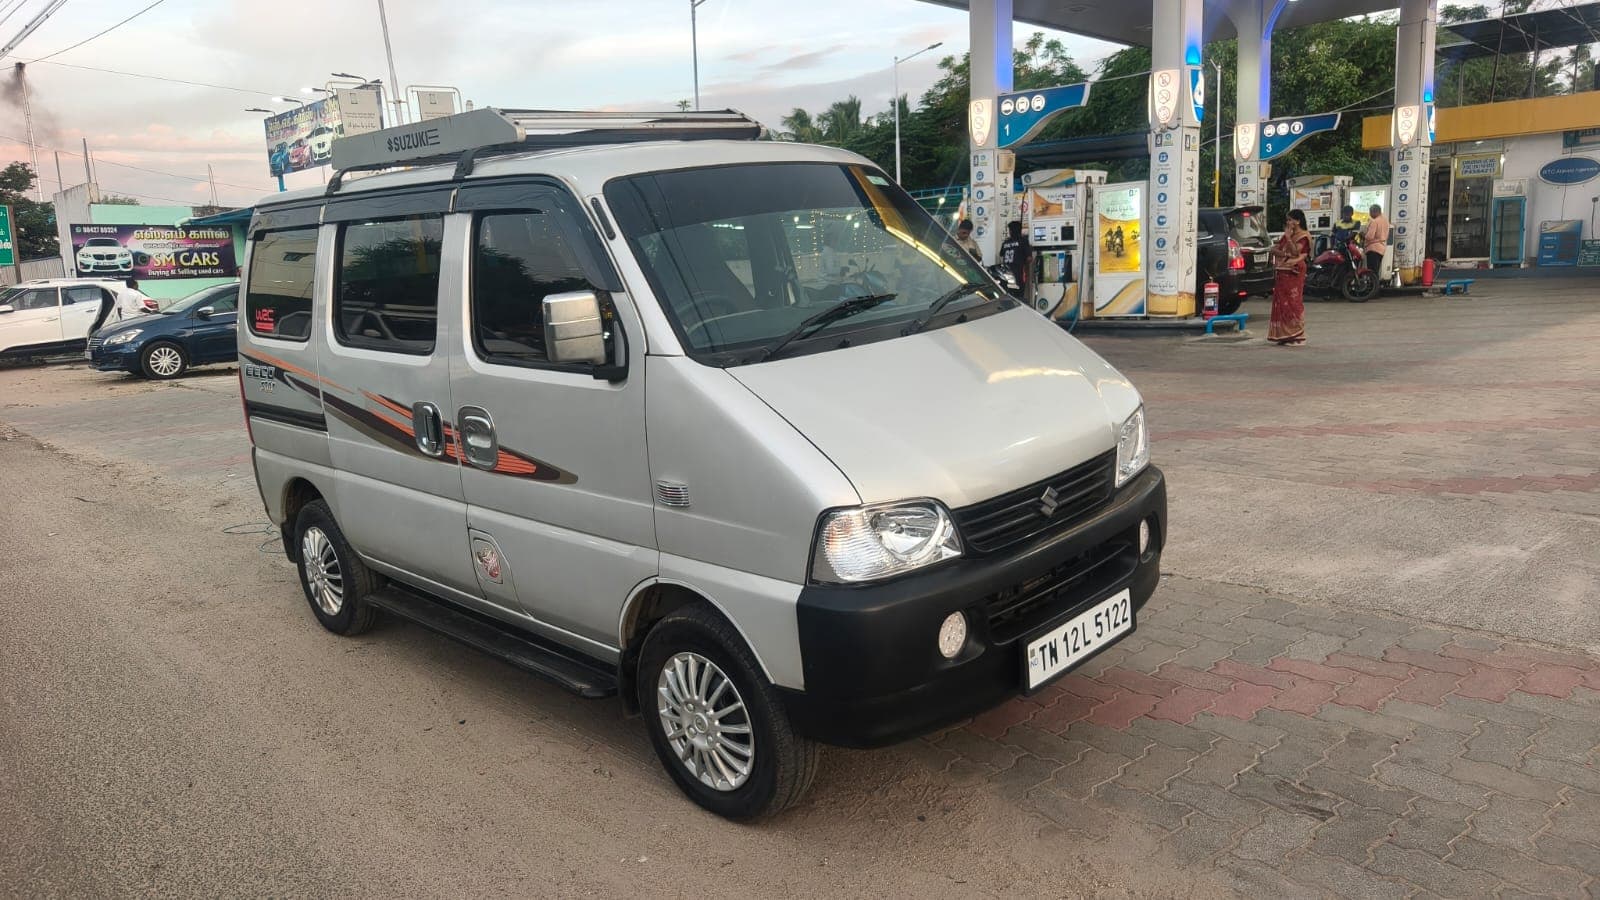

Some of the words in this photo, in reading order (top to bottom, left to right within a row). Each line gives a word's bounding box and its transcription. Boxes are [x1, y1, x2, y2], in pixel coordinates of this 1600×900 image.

[1004, 123, 1010, 136] 1
[393, 130, 429, 152] SUZUKI
[1265, 143, 1272, 153] 3
[153, 253, 175, 267] SM
[179, 252, 220, 267] CARS
[148, 269, 170, 277] Buying
[177, 268, 198, 276] Selling
[198, 267, 211, 275] used
[245, 363, 275, 380] EECO
[1039, 638, 1059, 671] TN
[1063, 622, 1092, 658] 12L
[1094, 598, 1129, 638] 5122
